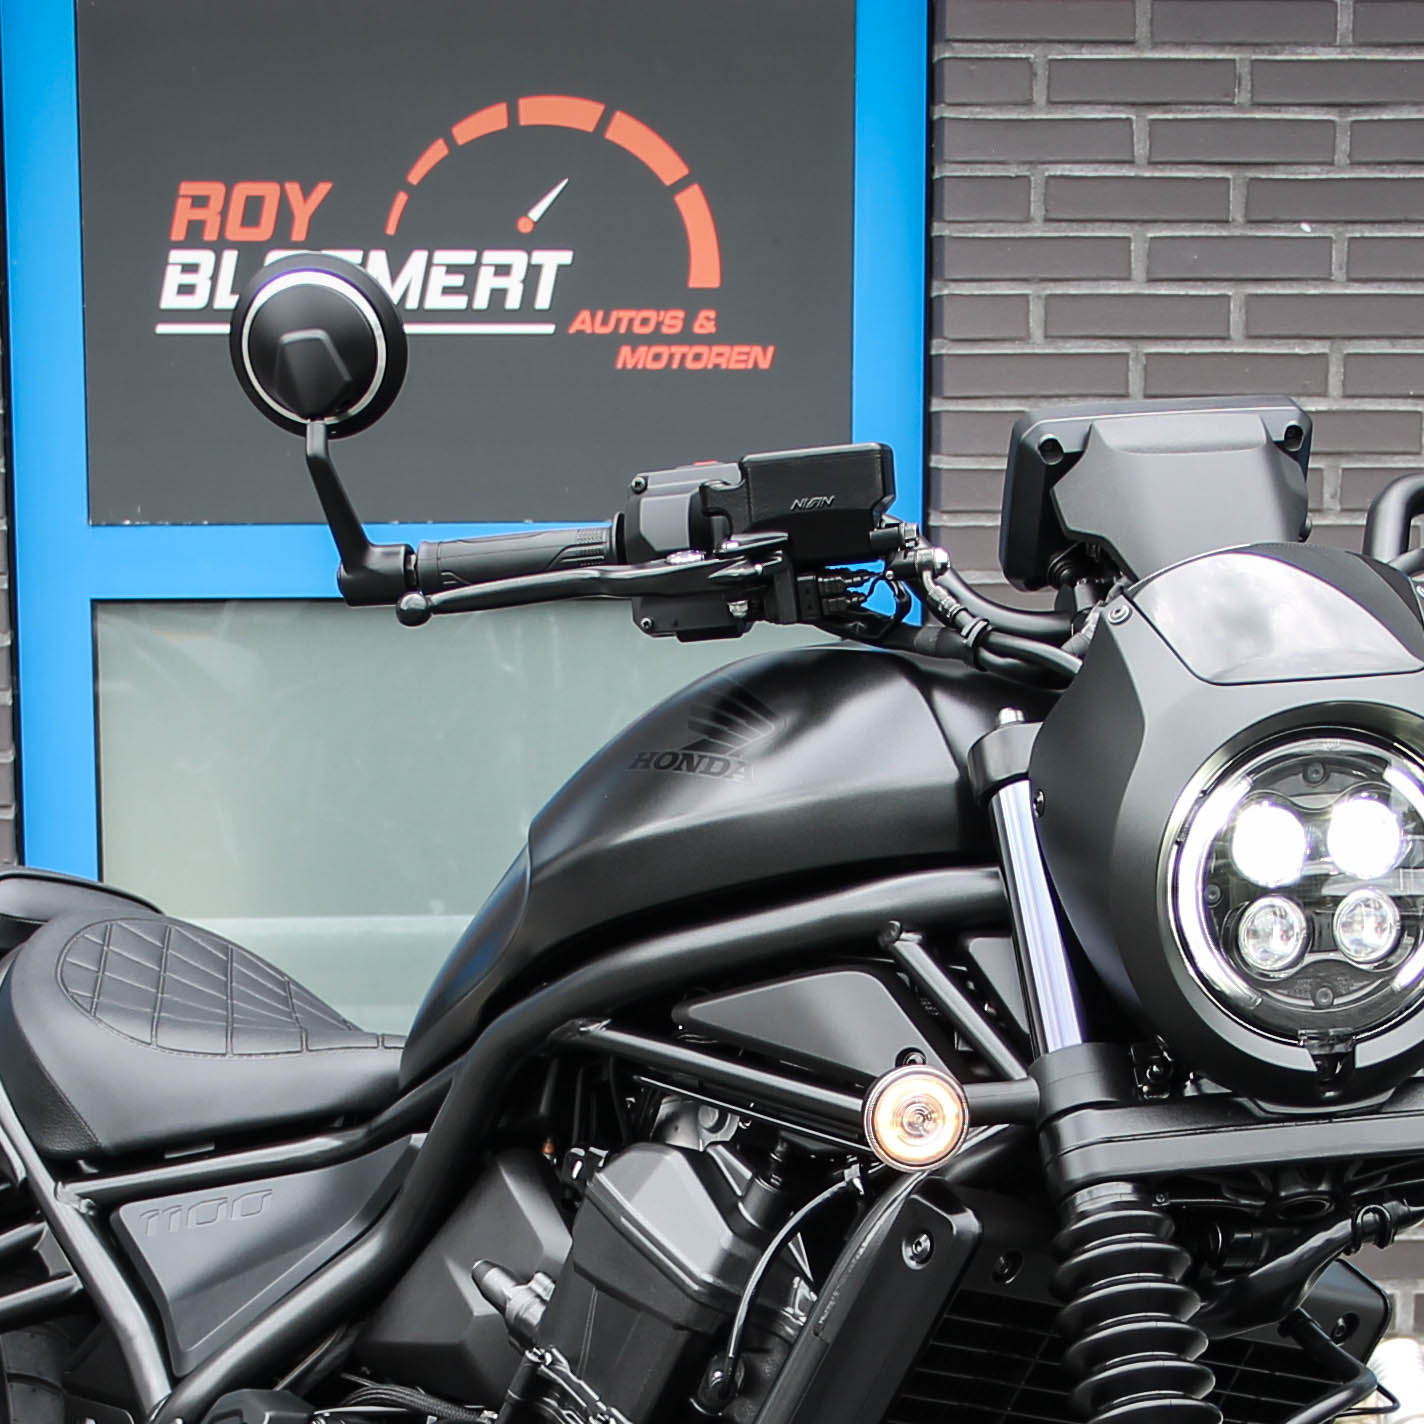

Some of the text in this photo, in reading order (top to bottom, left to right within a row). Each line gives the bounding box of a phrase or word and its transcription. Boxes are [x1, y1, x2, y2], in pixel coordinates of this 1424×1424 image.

[169, 181, 334, 242] ROY
[159, 249, 574, 310] BLMERT
[568, 309, 717, 334] AUTO'S &
[616, 345, 775, 370] MOTOREN
[138, 1189, 273, 1237] 1100
